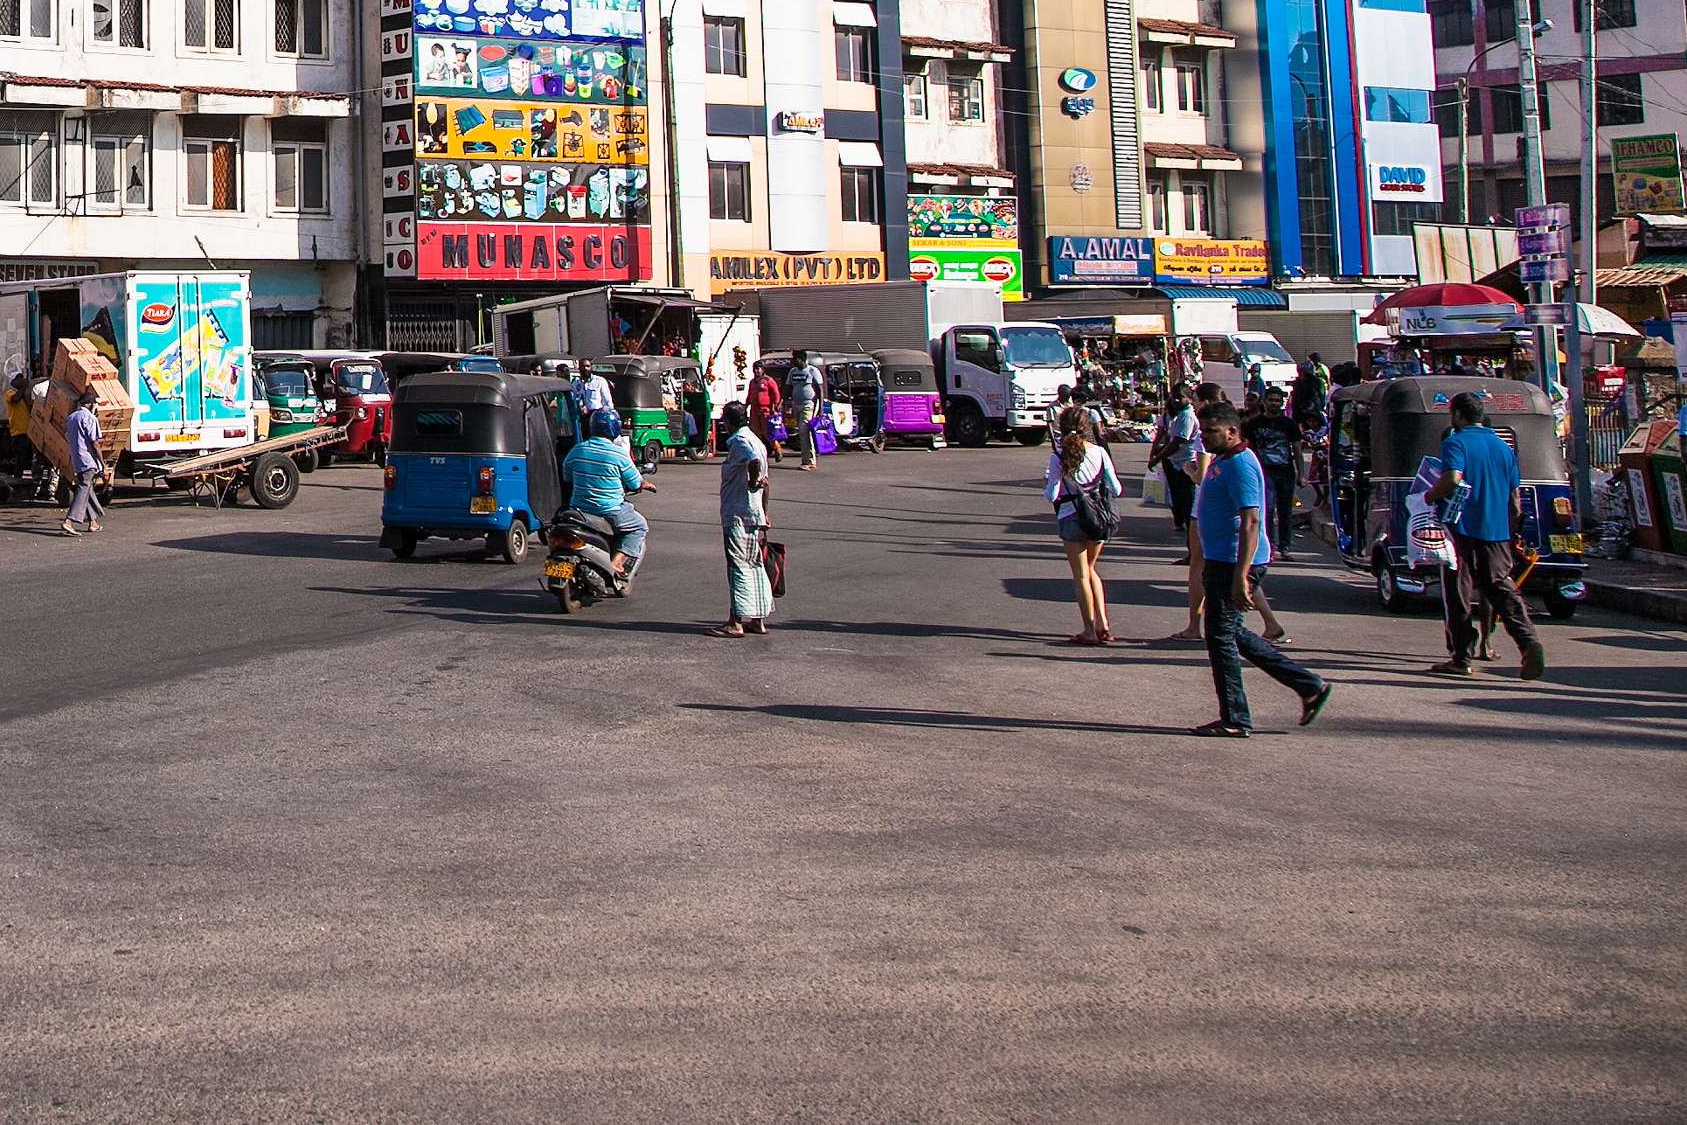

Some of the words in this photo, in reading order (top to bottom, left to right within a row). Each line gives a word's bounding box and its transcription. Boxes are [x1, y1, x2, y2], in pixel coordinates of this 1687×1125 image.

[1379, 166, 1426, 184] DAVID
[442, 232, 630, 270] MUNASCO
[1060, 237, 1152, 261] A.AMAL
[1175, 243, 1230, 258] Ravilanka
[709, 256, 779, 280] AMILEX
[847, 257, 881, 280] LTD
[429, 457, 446, 465] TVS
